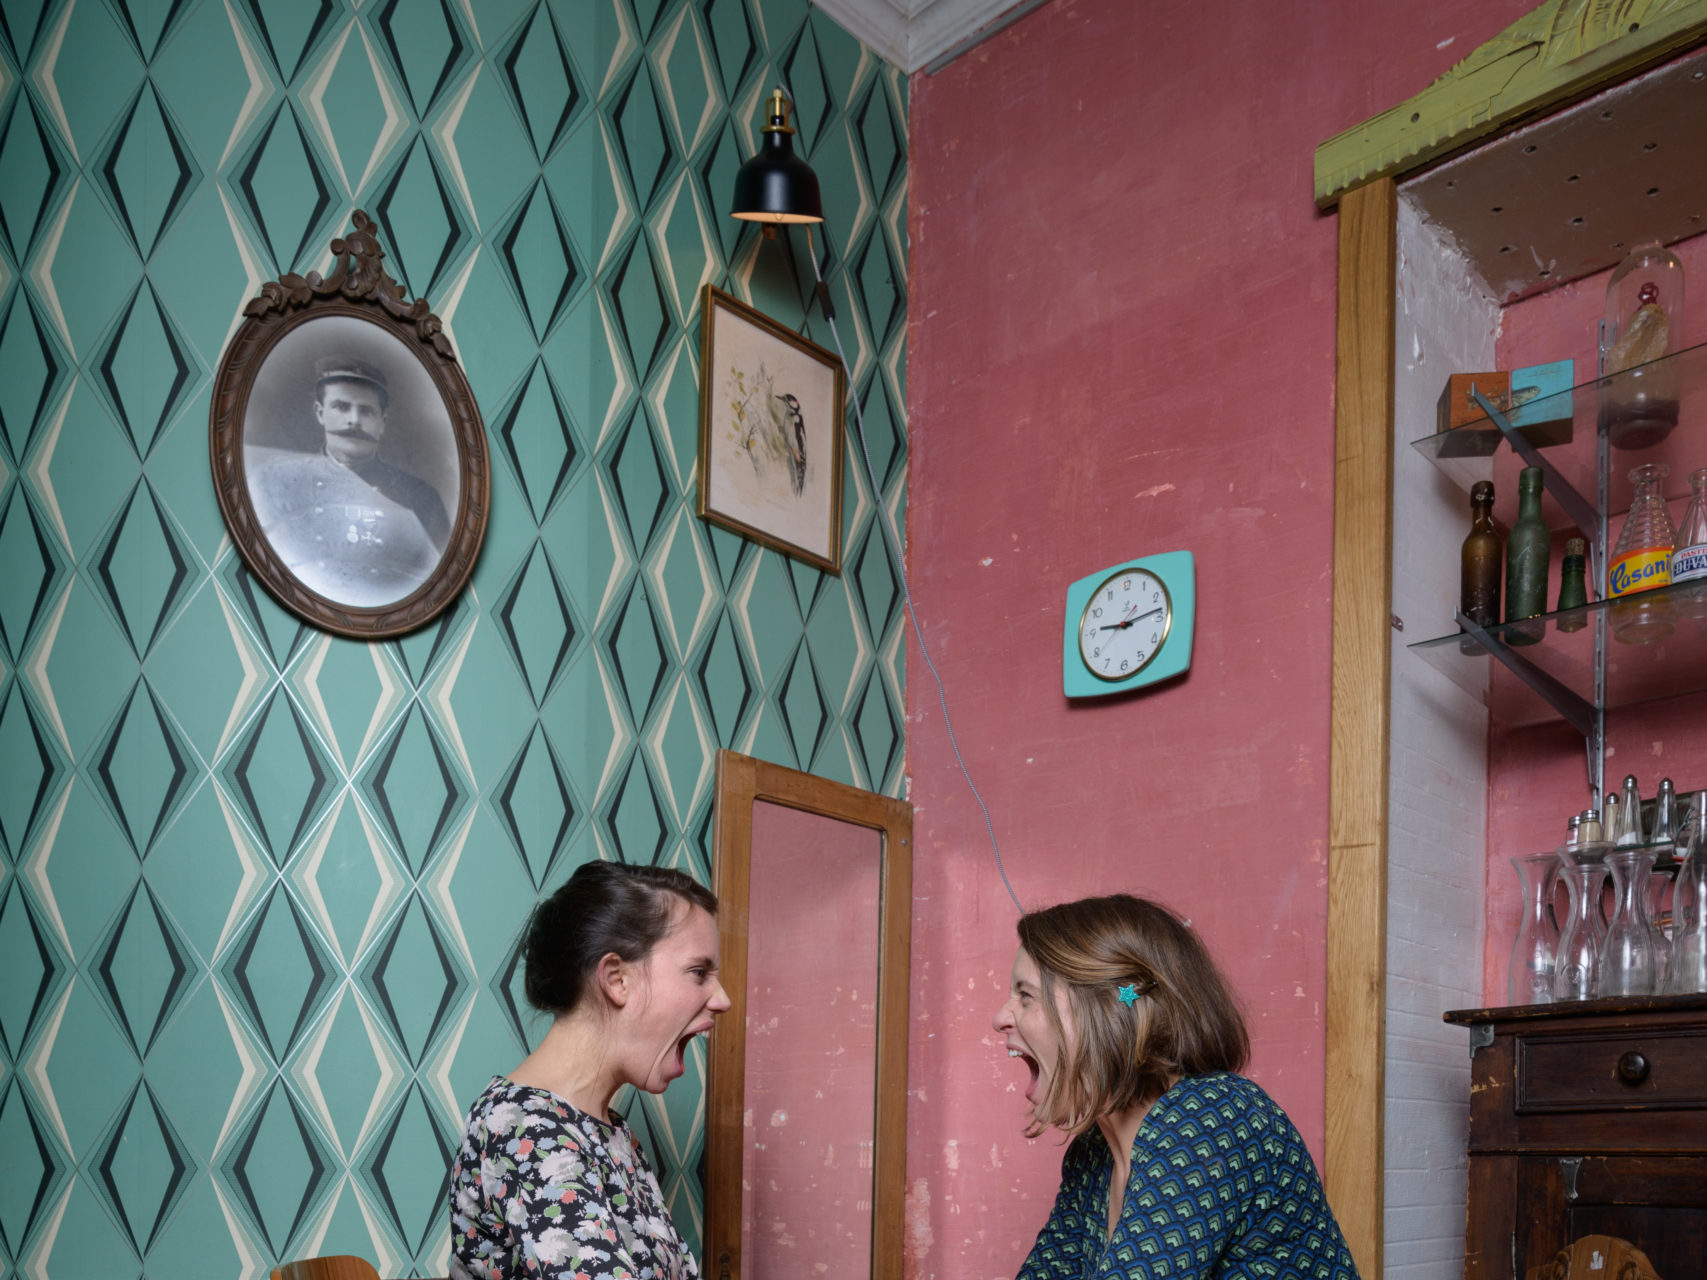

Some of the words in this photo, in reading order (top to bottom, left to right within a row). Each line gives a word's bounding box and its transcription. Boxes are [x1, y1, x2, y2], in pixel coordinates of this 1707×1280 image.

[1107, 590, 1114, 601] 11
[1153, 592, 1160, 603] 2
[1092, 607, 1103, 619] 10
[1155, 609, 1163, 622] 3
[1089, 628, 1097, 639] 9
[1151, 631, 1158, 644] 4
[1093, 647, 1100, 658] 8
[1137, 650, 1145, 662] 5
[1104, 658, 1111, 669] 7
[1120, 659, 1128, 671] 6
